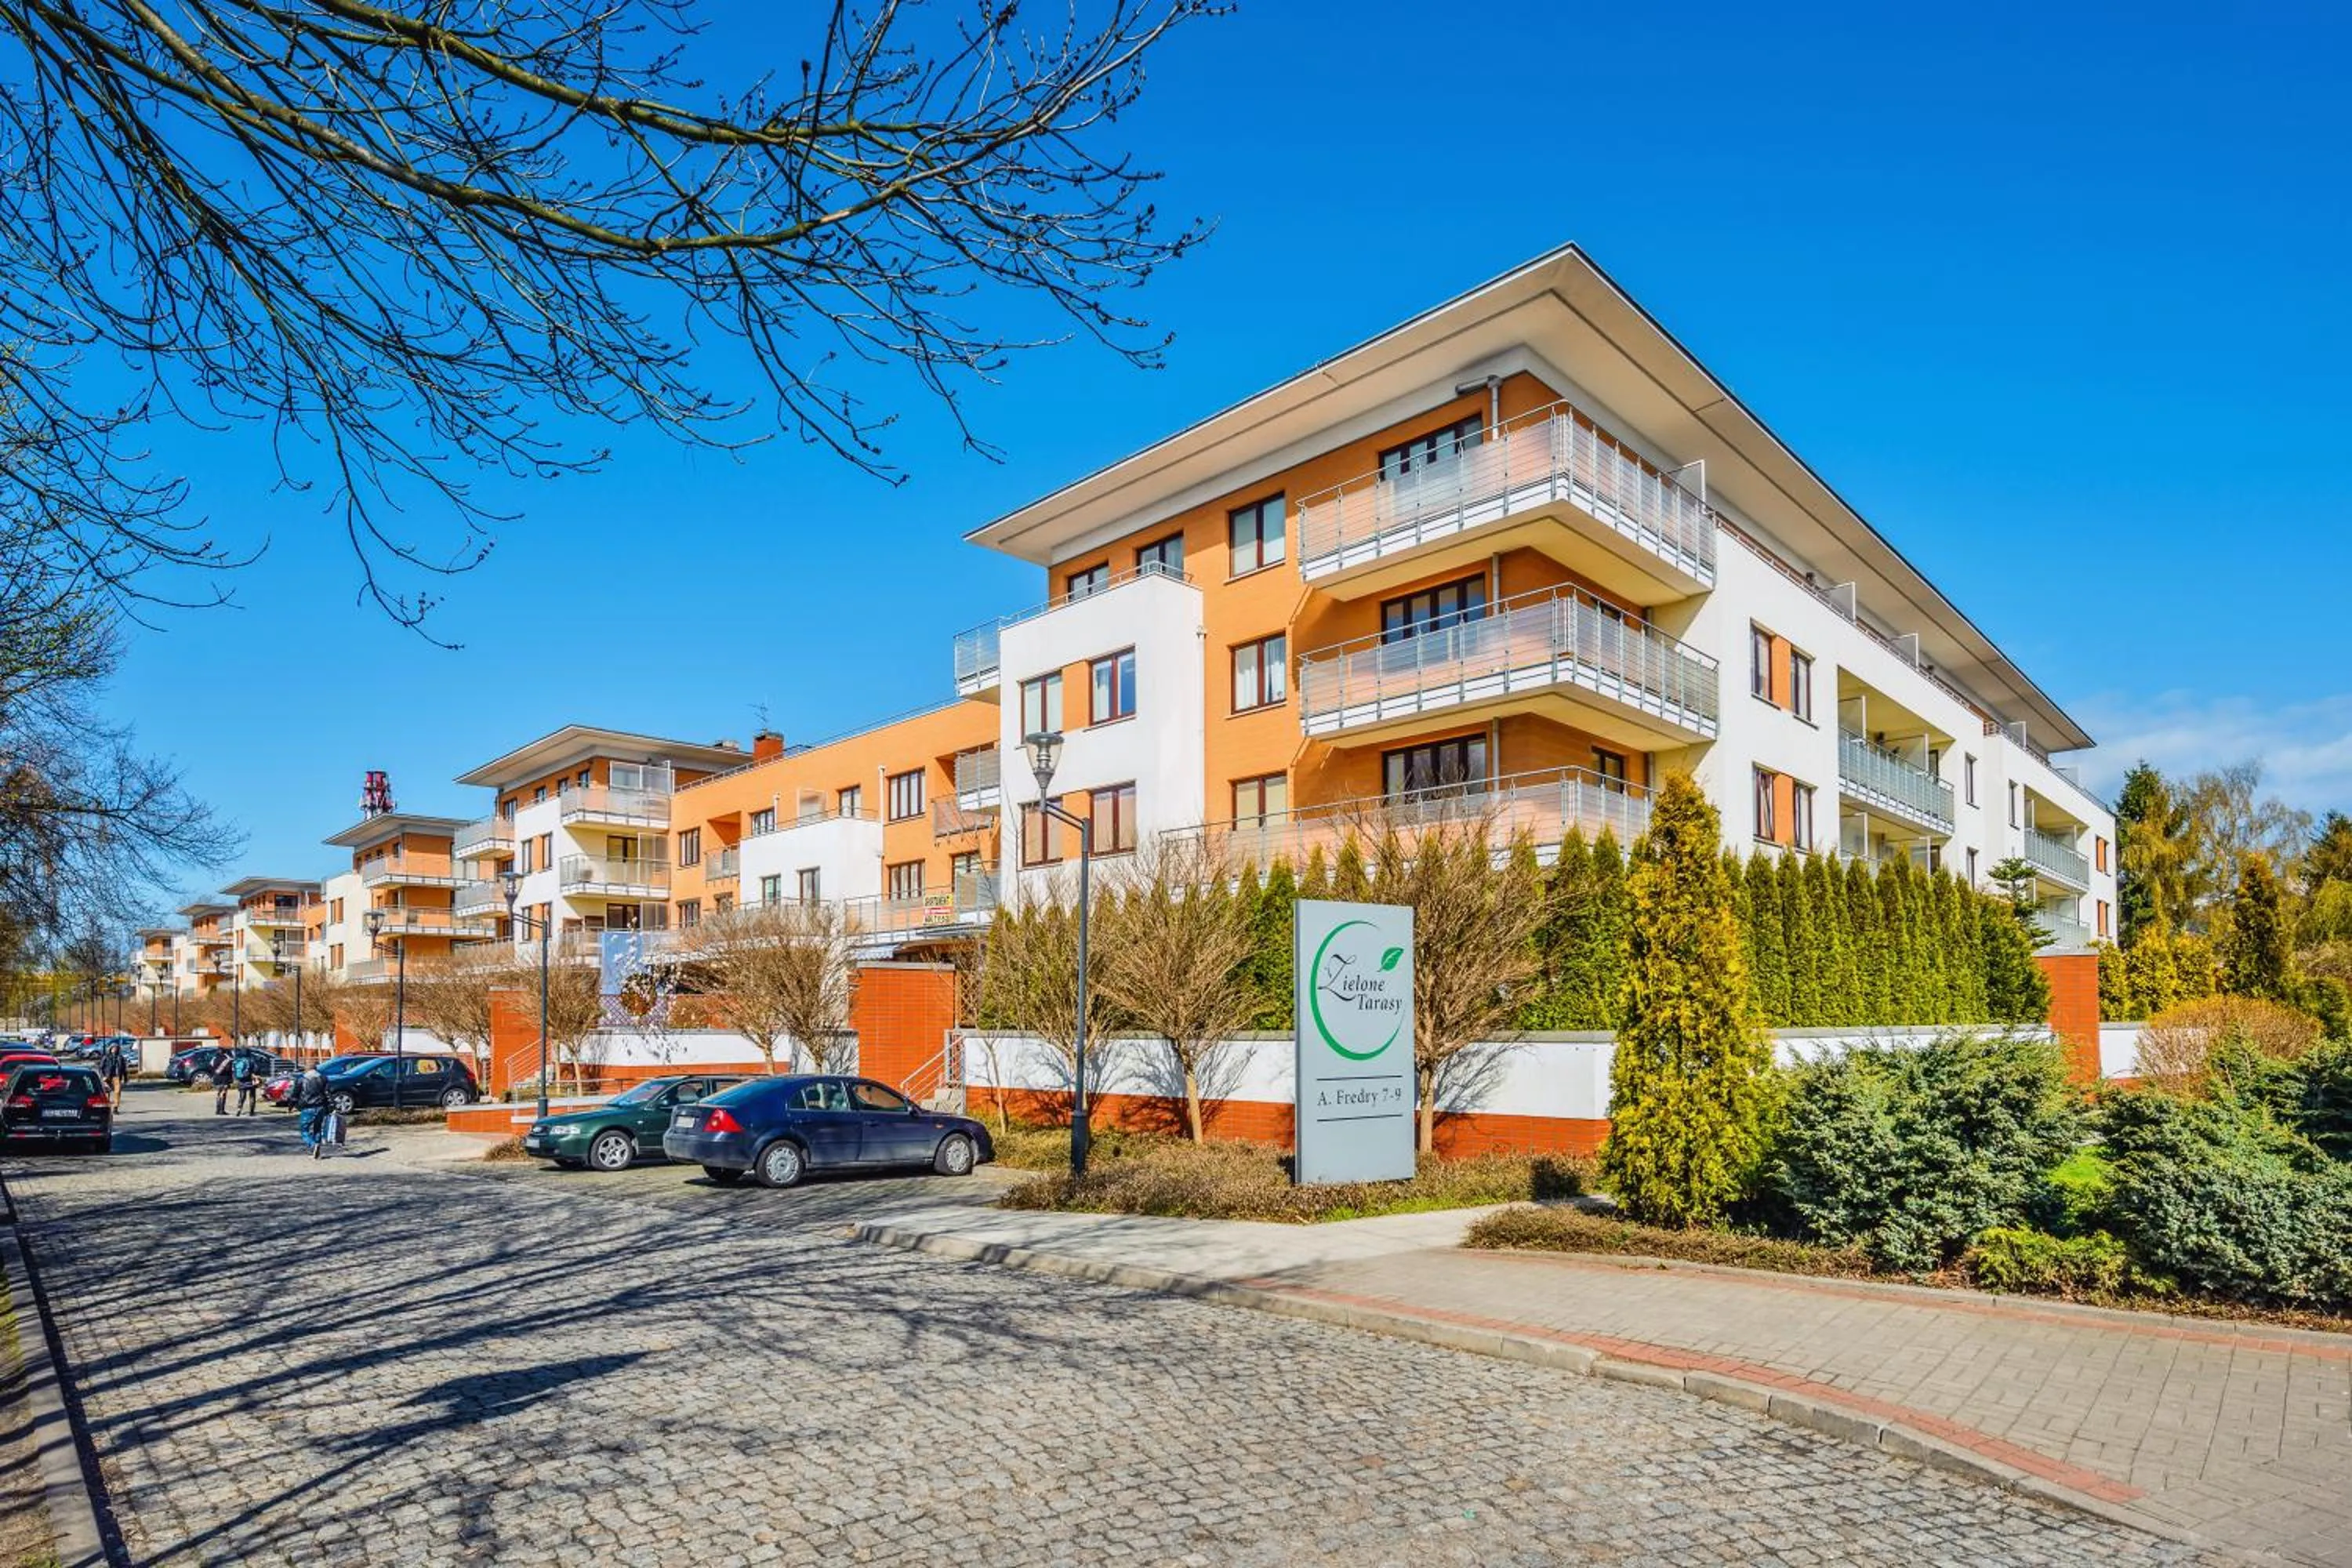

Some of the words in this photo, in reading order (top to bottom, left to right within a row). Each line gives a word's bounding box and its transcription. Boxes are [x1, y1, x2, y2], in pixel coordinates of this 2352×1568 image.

[1317, 953, 1385, 1001] Zielone
[1358, 993, 1403, 1015] Tarasy
[1317, 1091, 1332, 1106] A.
[1337, 1088, 1379, 1108] Fredry
[1382, 1087, 1401, 1102] 7-9
